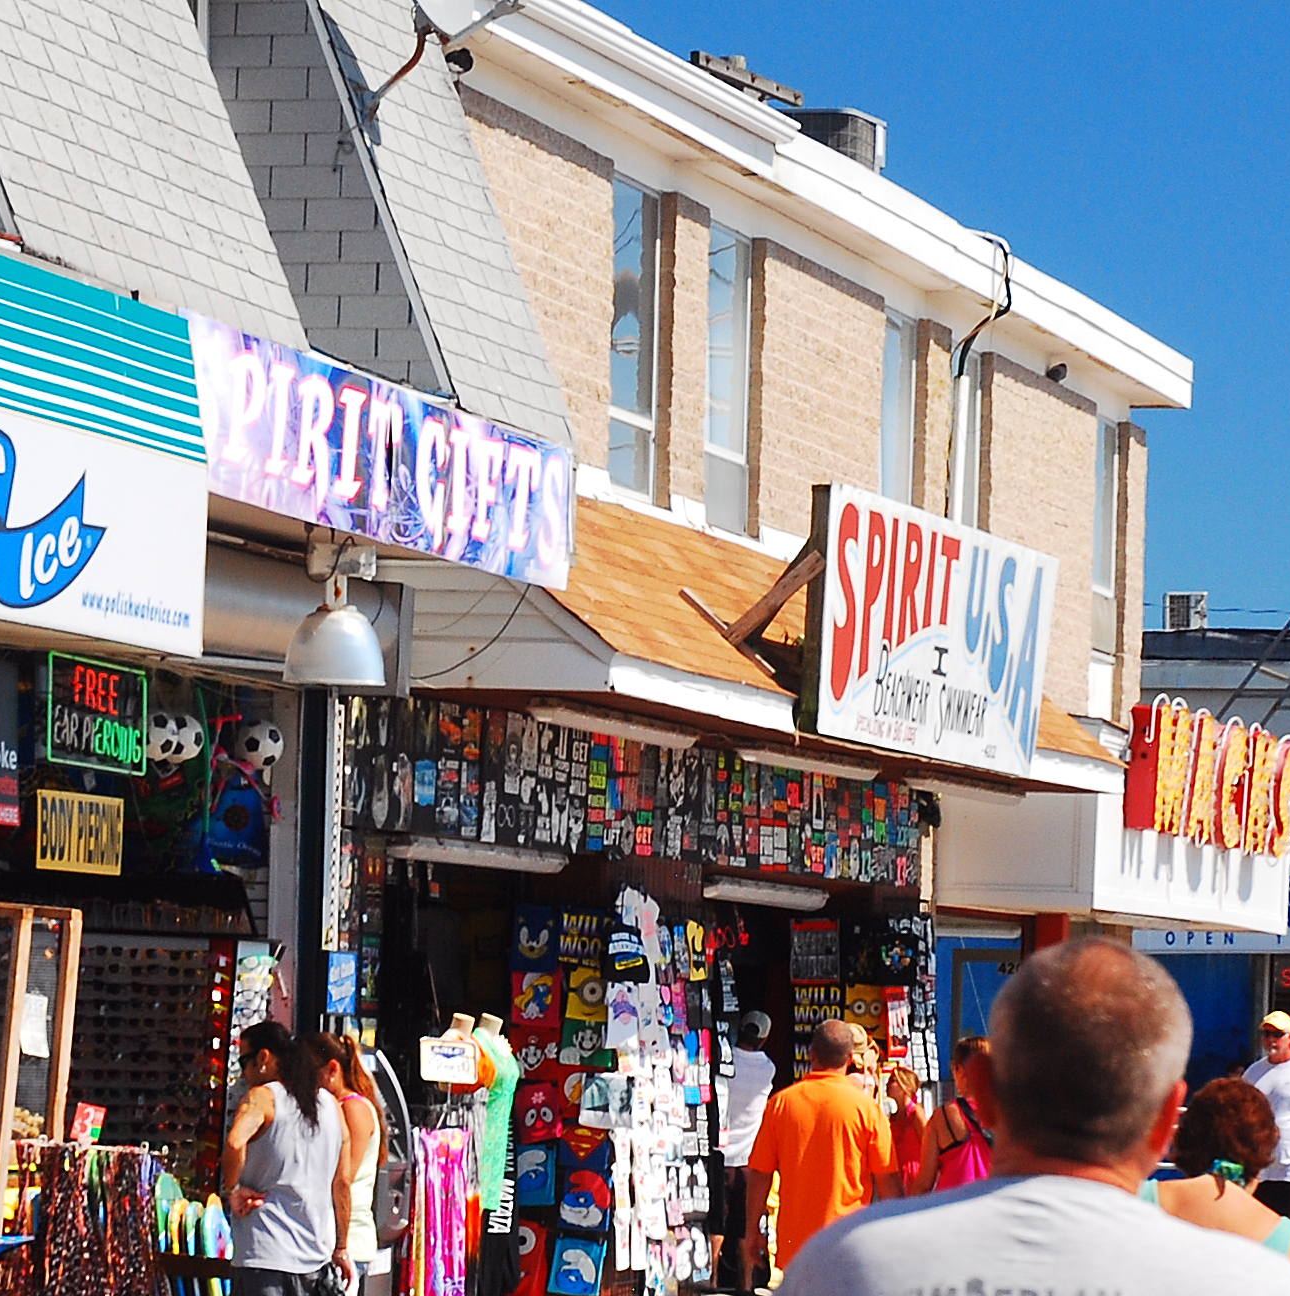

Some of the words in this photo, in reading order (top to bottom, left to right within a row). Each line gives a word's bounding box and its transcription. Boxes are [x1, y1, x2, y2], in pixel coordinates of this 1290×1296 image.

[415, 415, 567, 570] GIFTS
[19, 522, 83, 600] Ice
[830, 502, 962, 703] SPIRIT
[73, 665, 120, 716] FREE
[53, 704, 78, 751] EAR
[0, 808, 19, 824] HERE
[40, 796, 72, 862] BODY
[1165, 931, 1235, 946] OPEN
[794, 986, 841, 1005] WILD
[794, 1005, 841, 1023] WOOD
